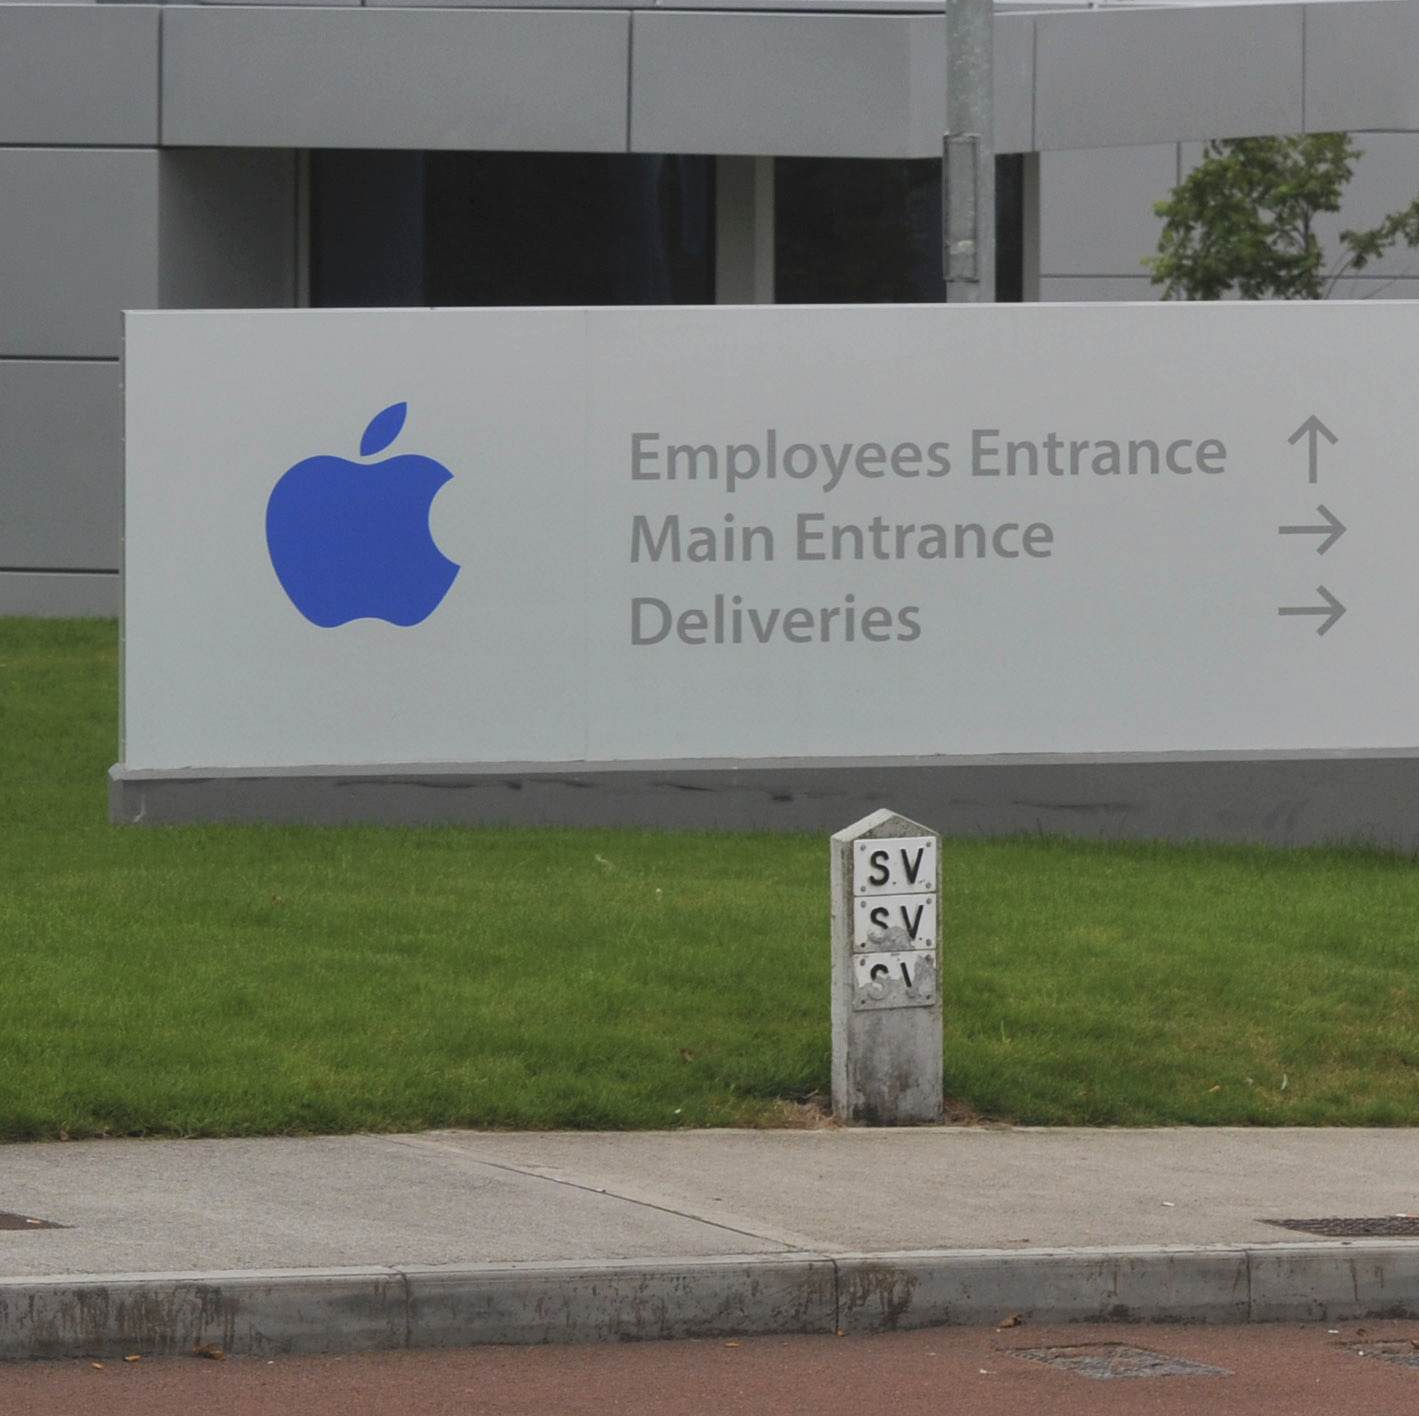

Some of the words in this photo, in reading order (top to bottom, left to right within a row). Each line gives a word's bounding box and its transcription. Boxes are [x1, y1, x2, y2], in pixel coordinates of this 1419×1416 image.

[629, 429, 952, 493] Employees
[970, 428, 1228, 477] Entrance
[629, 513, 775, 563] Main
[795, 512, 1055, 562] Entrance
[629, 593, 922, 646] Deliveries
